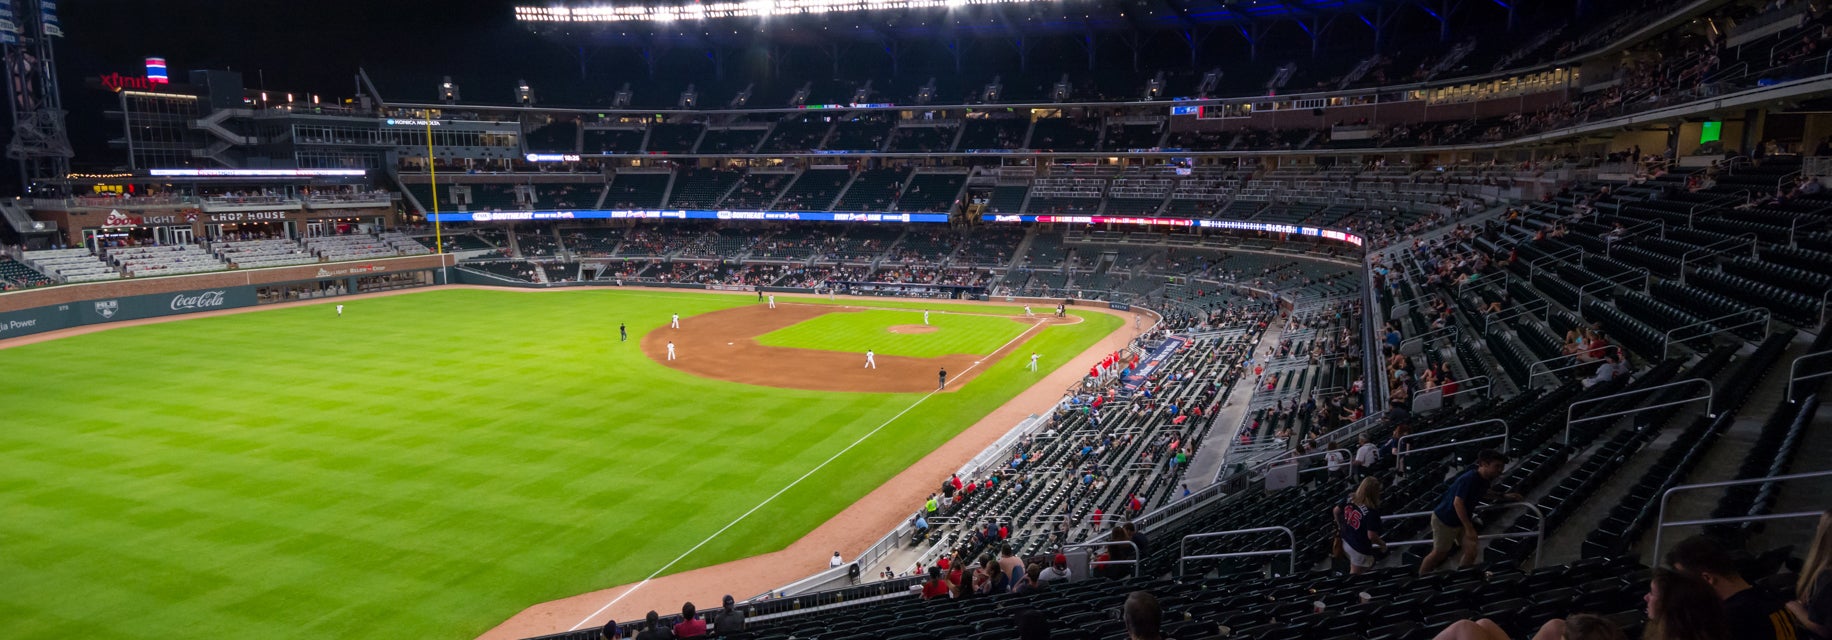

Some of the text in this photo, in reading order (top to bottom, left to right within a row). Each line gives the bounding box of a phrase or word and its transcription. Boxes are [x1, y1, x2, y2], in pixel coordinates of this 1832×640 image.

[101, 72, 157, 92] xfinity
[143, 215, 176, 224] LIGHT
[211, 211, 286, 221] CHOP HOUSE
[491, 212, 534, 220] SOUTHEAST
[170, 290, 226, 311] Coca-Cola
[10, 319, 37, 329] Power
